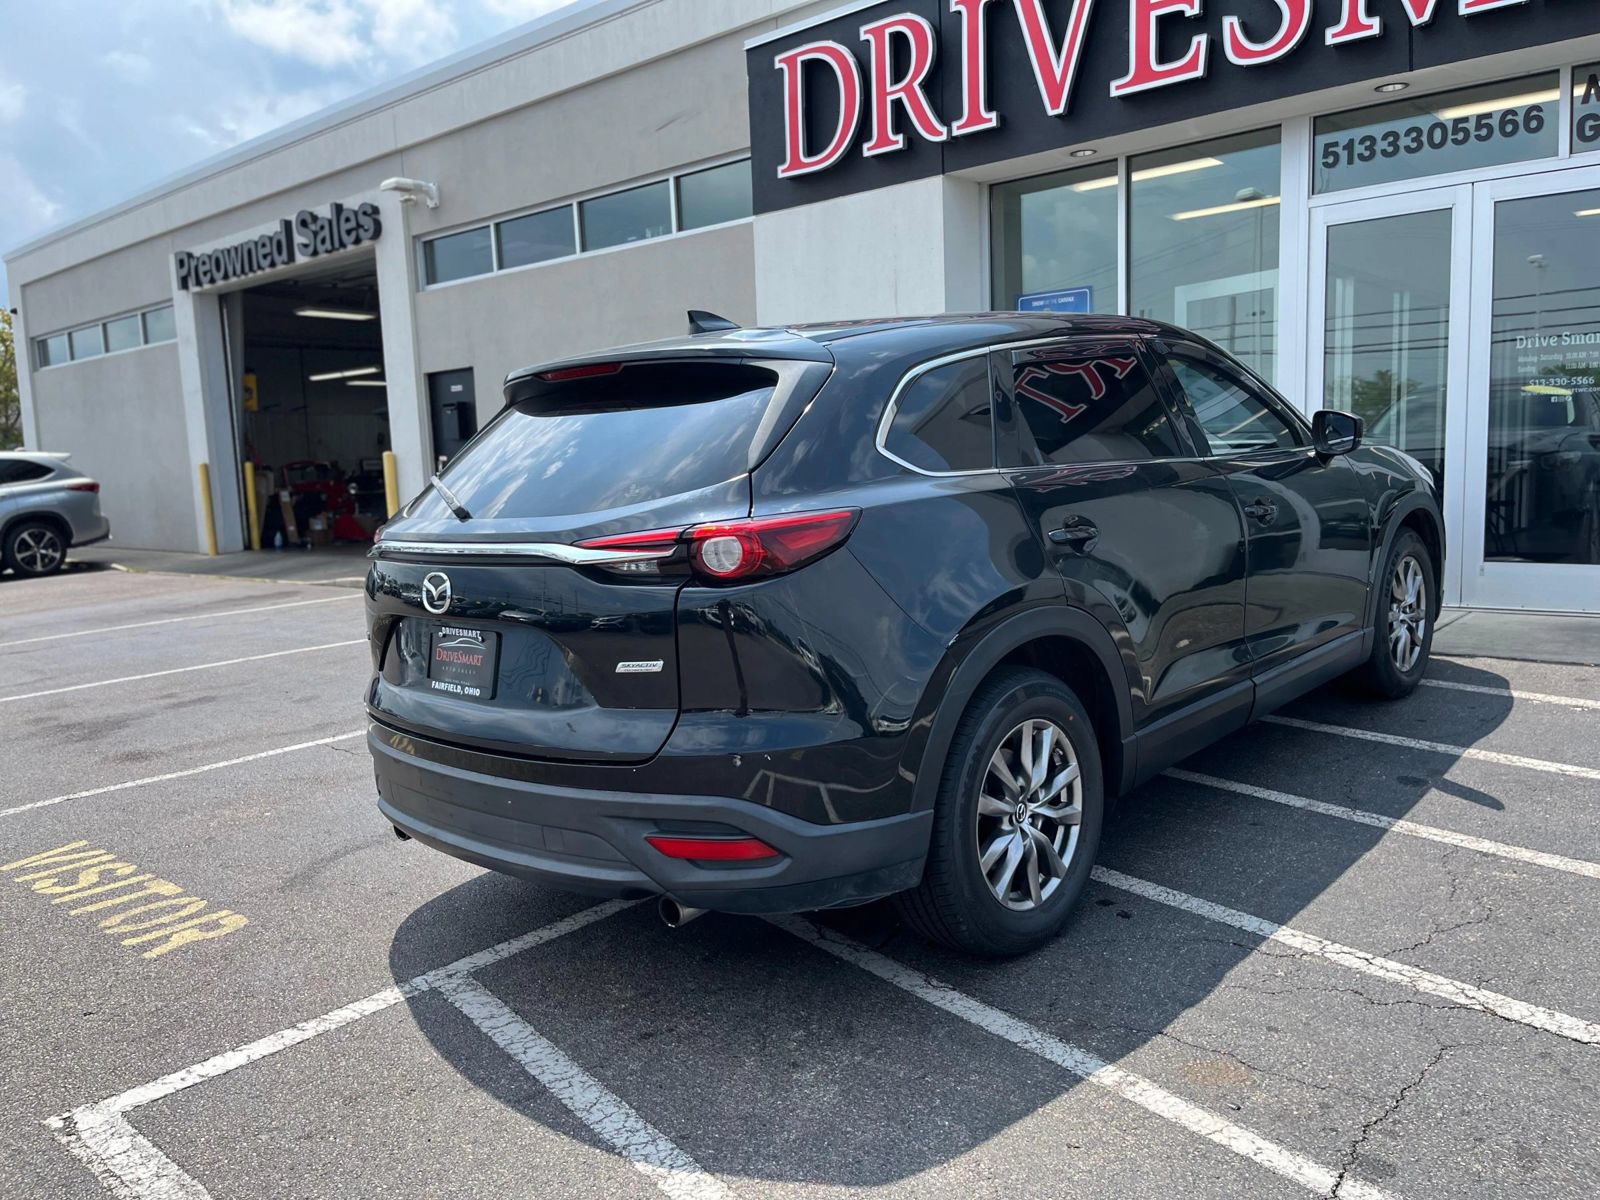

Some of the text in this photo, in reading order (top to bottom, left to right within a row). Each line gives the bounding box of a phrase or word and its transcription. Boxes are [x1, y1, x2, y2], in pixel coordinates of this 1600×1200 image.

[774, 0, 1530, 178] DRIVE
[1321, 105, 1545, 169] 5133305566
[175, 202, 382, 290] Preowned Sales
[1516, 334, 1557, 348] Drive
[441, 627, 480, 637] DRIVESMART
[431, 681, 463, 694] FAIRFIELD,
[464, 686, 481, 696] OHIO
[0, 840, 249, 959] VISITOR
